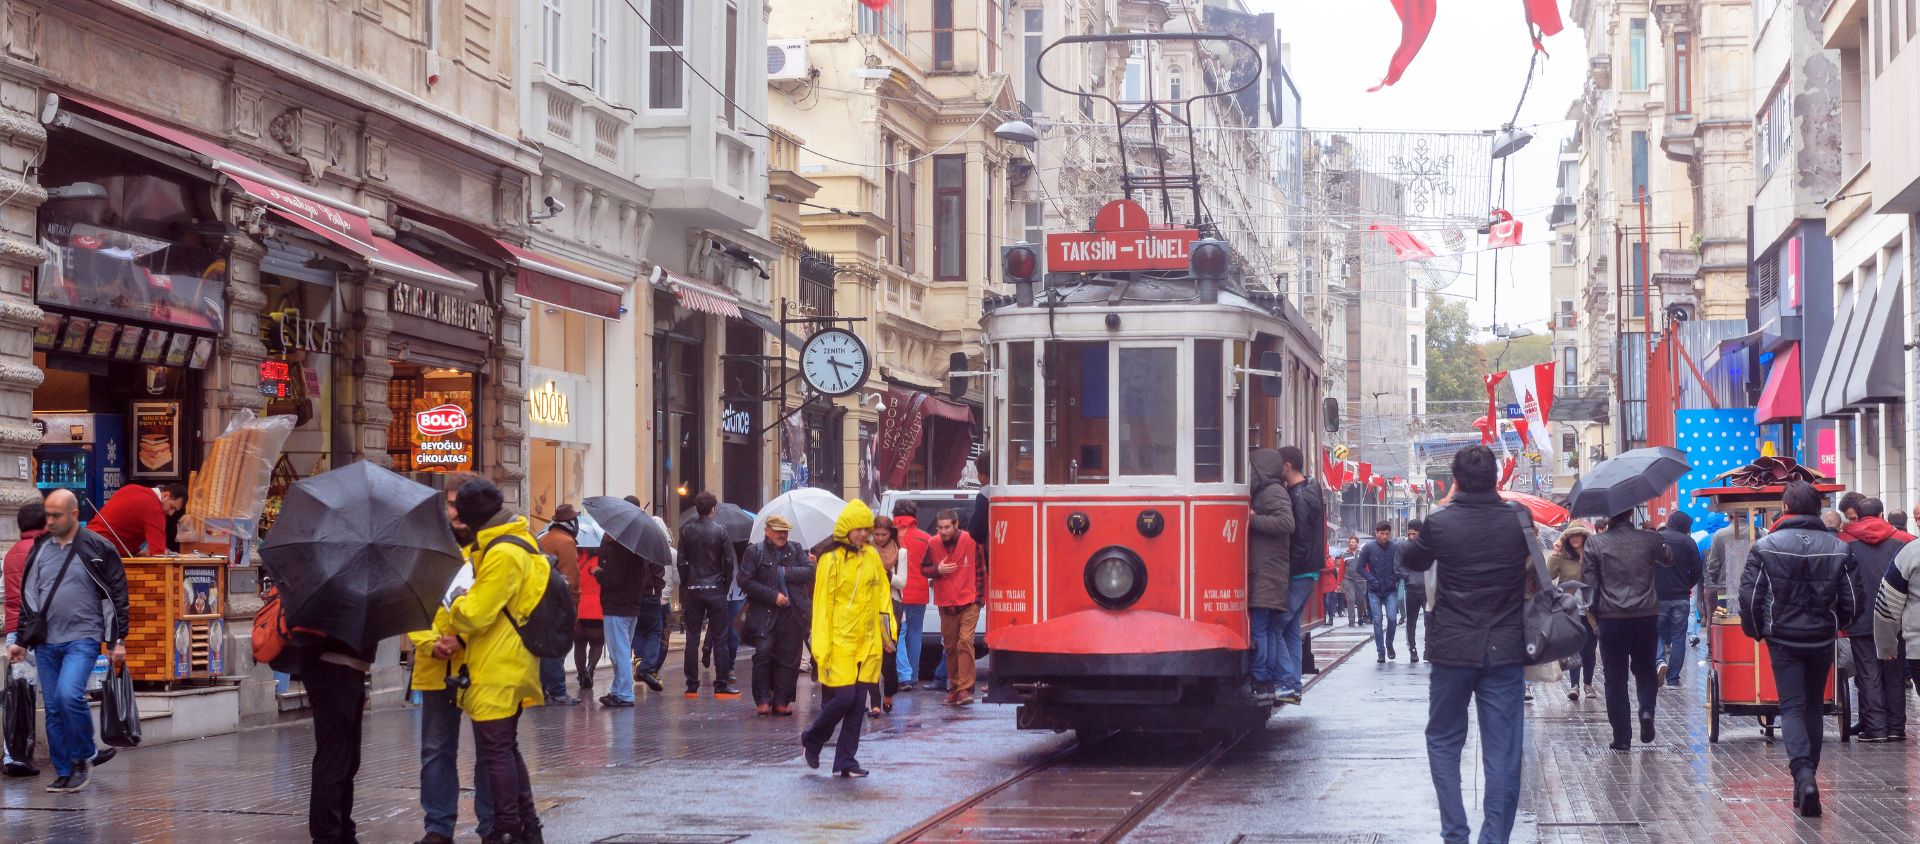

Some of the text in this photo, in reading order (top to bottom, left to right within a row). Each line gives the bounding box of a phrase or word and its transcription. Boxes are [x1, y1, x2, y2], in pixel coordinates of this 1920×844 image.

[1117, 203, 1125, 228] 1
[47, 222, 71, 237] ANTAKY
[1060, 236, 1116, 261] TAKSİM
[1135, 236, 1188, 259] TÜNEL
[529, 389, 570, 423] ANDORA
[882, 397, 898, 449] BOOKS
[421, 440, 463, 451] BEYOĞLU
[416, 453, 467, 464] ÇİKOLATASI
[1821, 454, 1836, 465] SNE
[1518, 473, 1552, 485] SHKE
[994, 520, 1008, 544] 47
[1222, 519, 1238, 543] 47
[1006, 590, 1026, 599] YASAK
[1203, 602, 1213, 612] VE
